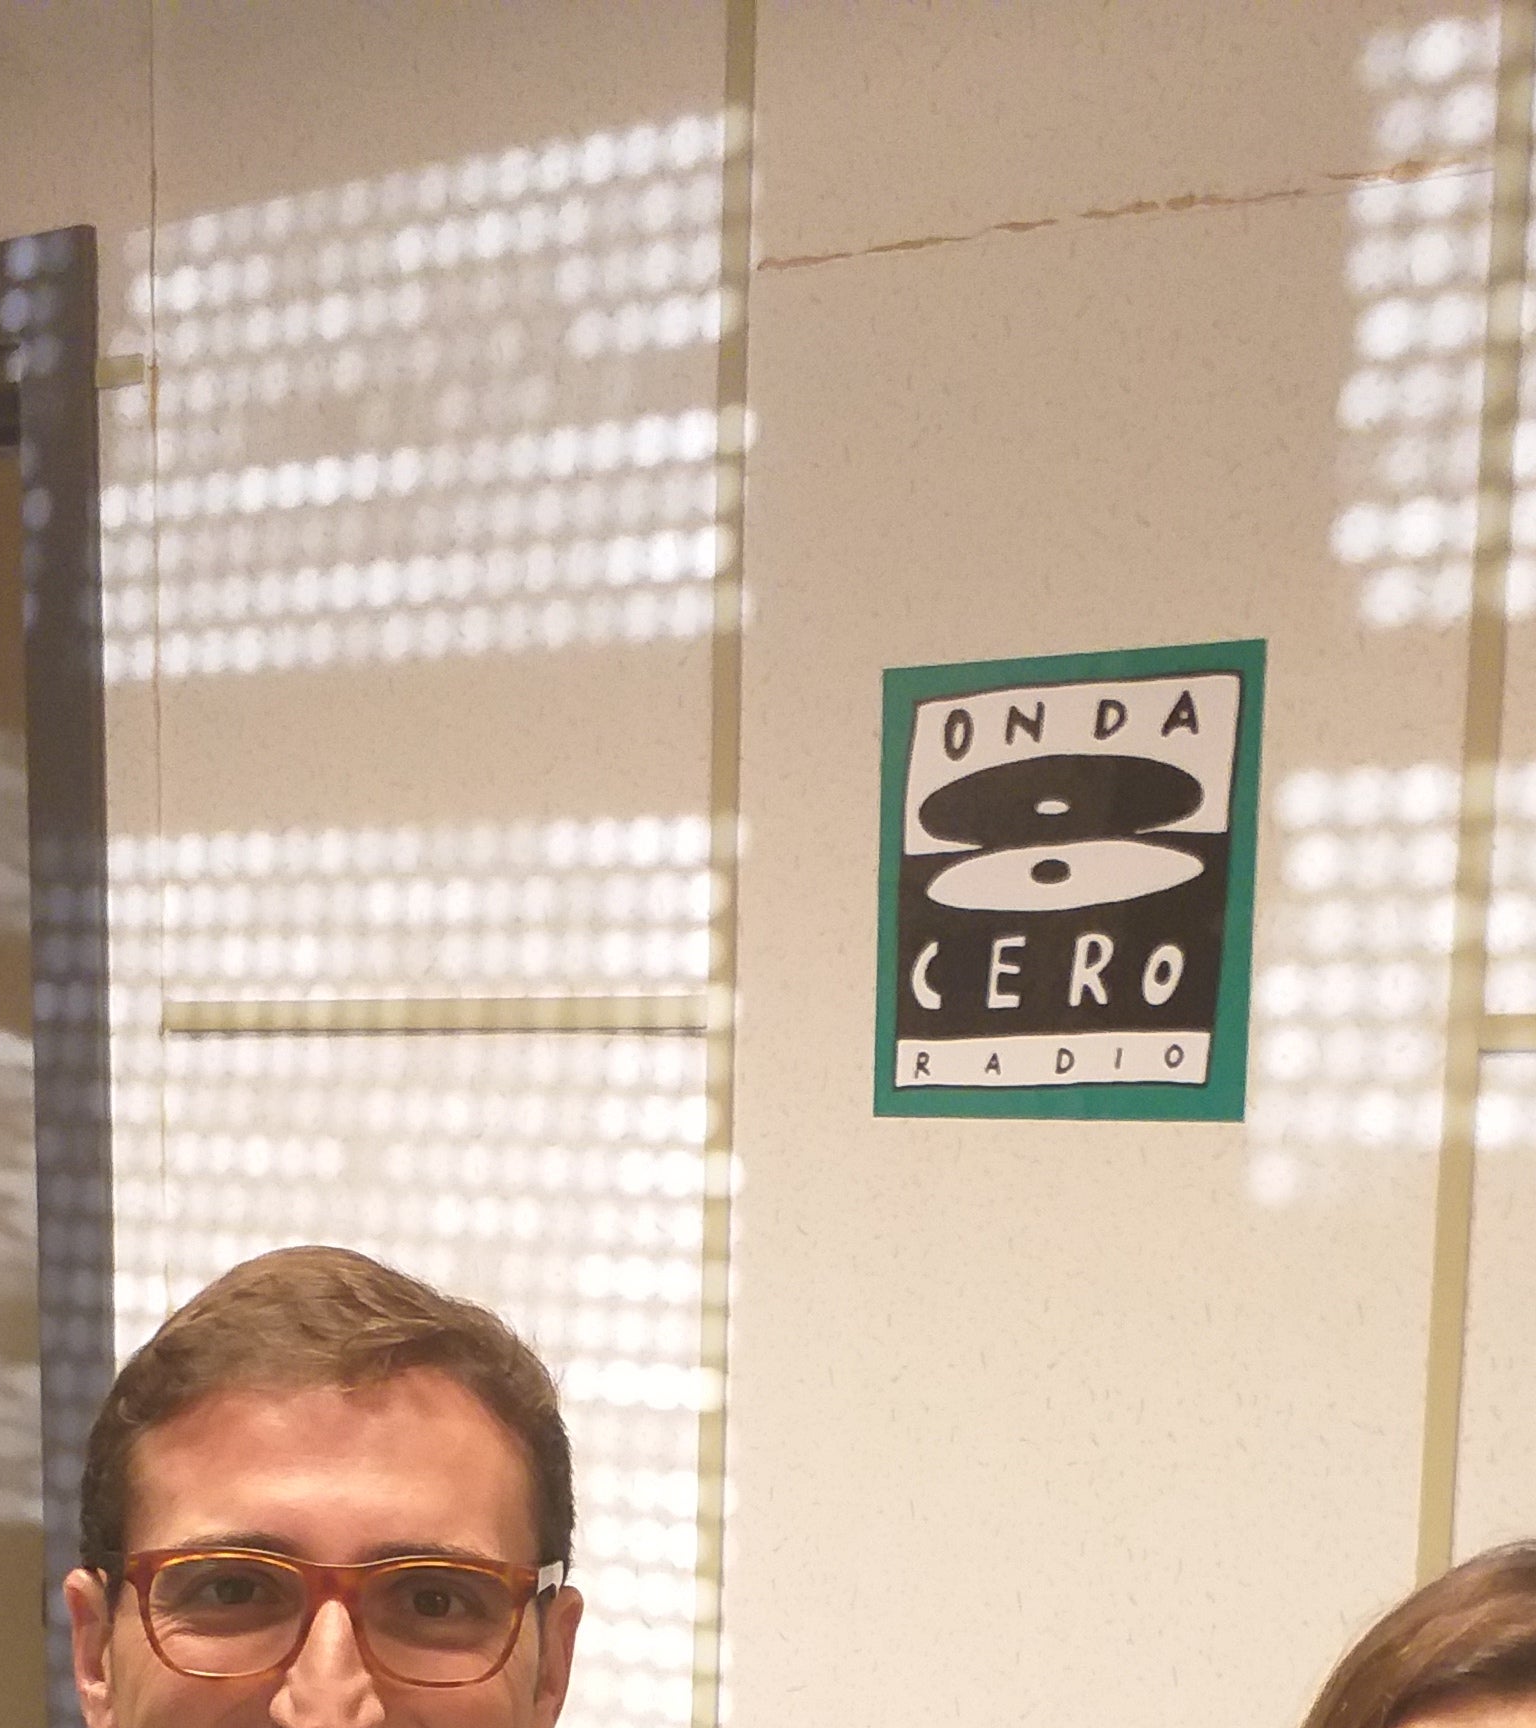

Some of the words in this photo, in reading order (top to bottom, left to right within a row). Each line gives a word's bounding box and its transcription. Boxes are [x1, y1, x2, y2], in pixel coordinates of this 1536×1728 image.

[943, 690, 1199, 762] ONDA
[911, 932, 1185, 1011] CERO
[914, 1044, 1184, 1077] RADIO
